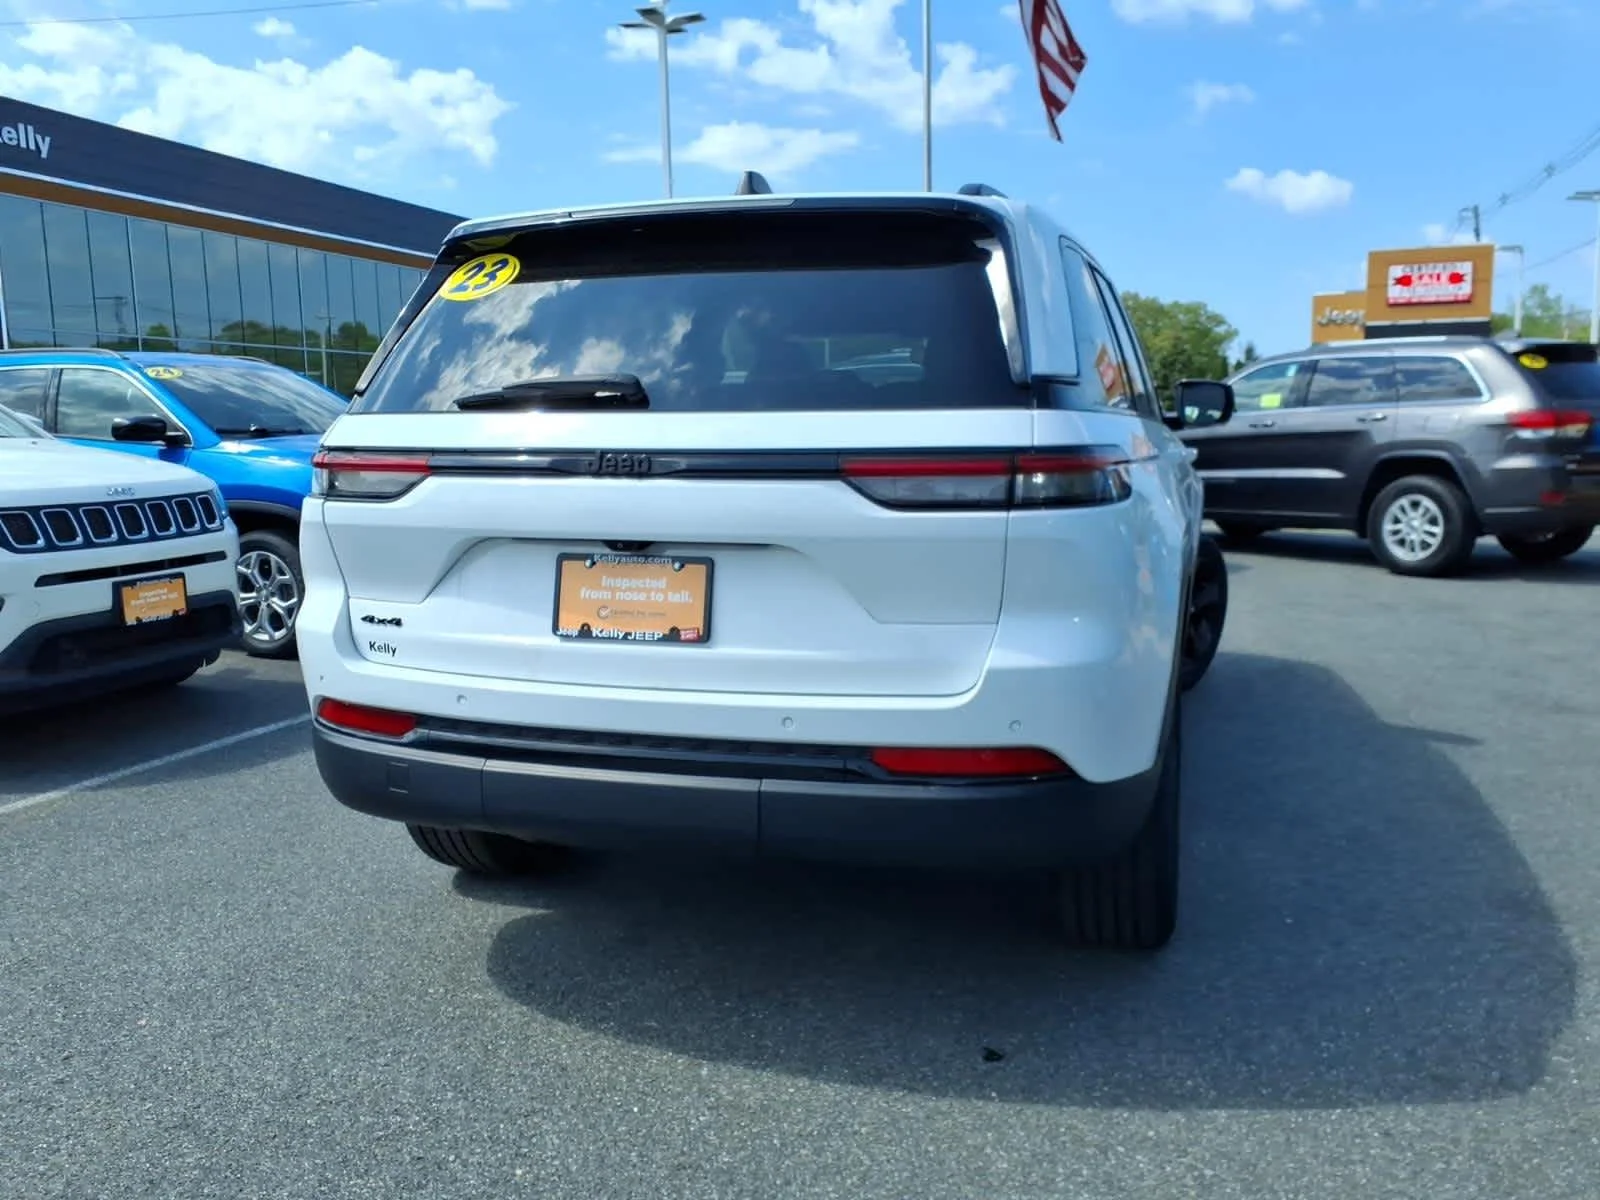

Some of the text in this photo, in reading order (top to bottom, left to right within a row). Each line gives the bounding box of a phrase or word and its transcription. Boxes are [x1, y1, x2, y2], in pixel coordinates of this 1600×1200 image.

[0, 122, 51, 159] elly
[448, 258, 509, 293] 23
[585, 450, 652, 477] Jeep
[594, 554, 673, 565] Kellyauto.com
[602, 576, 667, 590] Inspected
[580, 587, 612, 599] from
[615, 589, 647, 600] nose
[651, 591, 664, 601] to
[360, 614, 404, 628] 4x4
[592, 627, 664, 640] Kelly JEEP
[368, 640, 398, 658] Kelly
